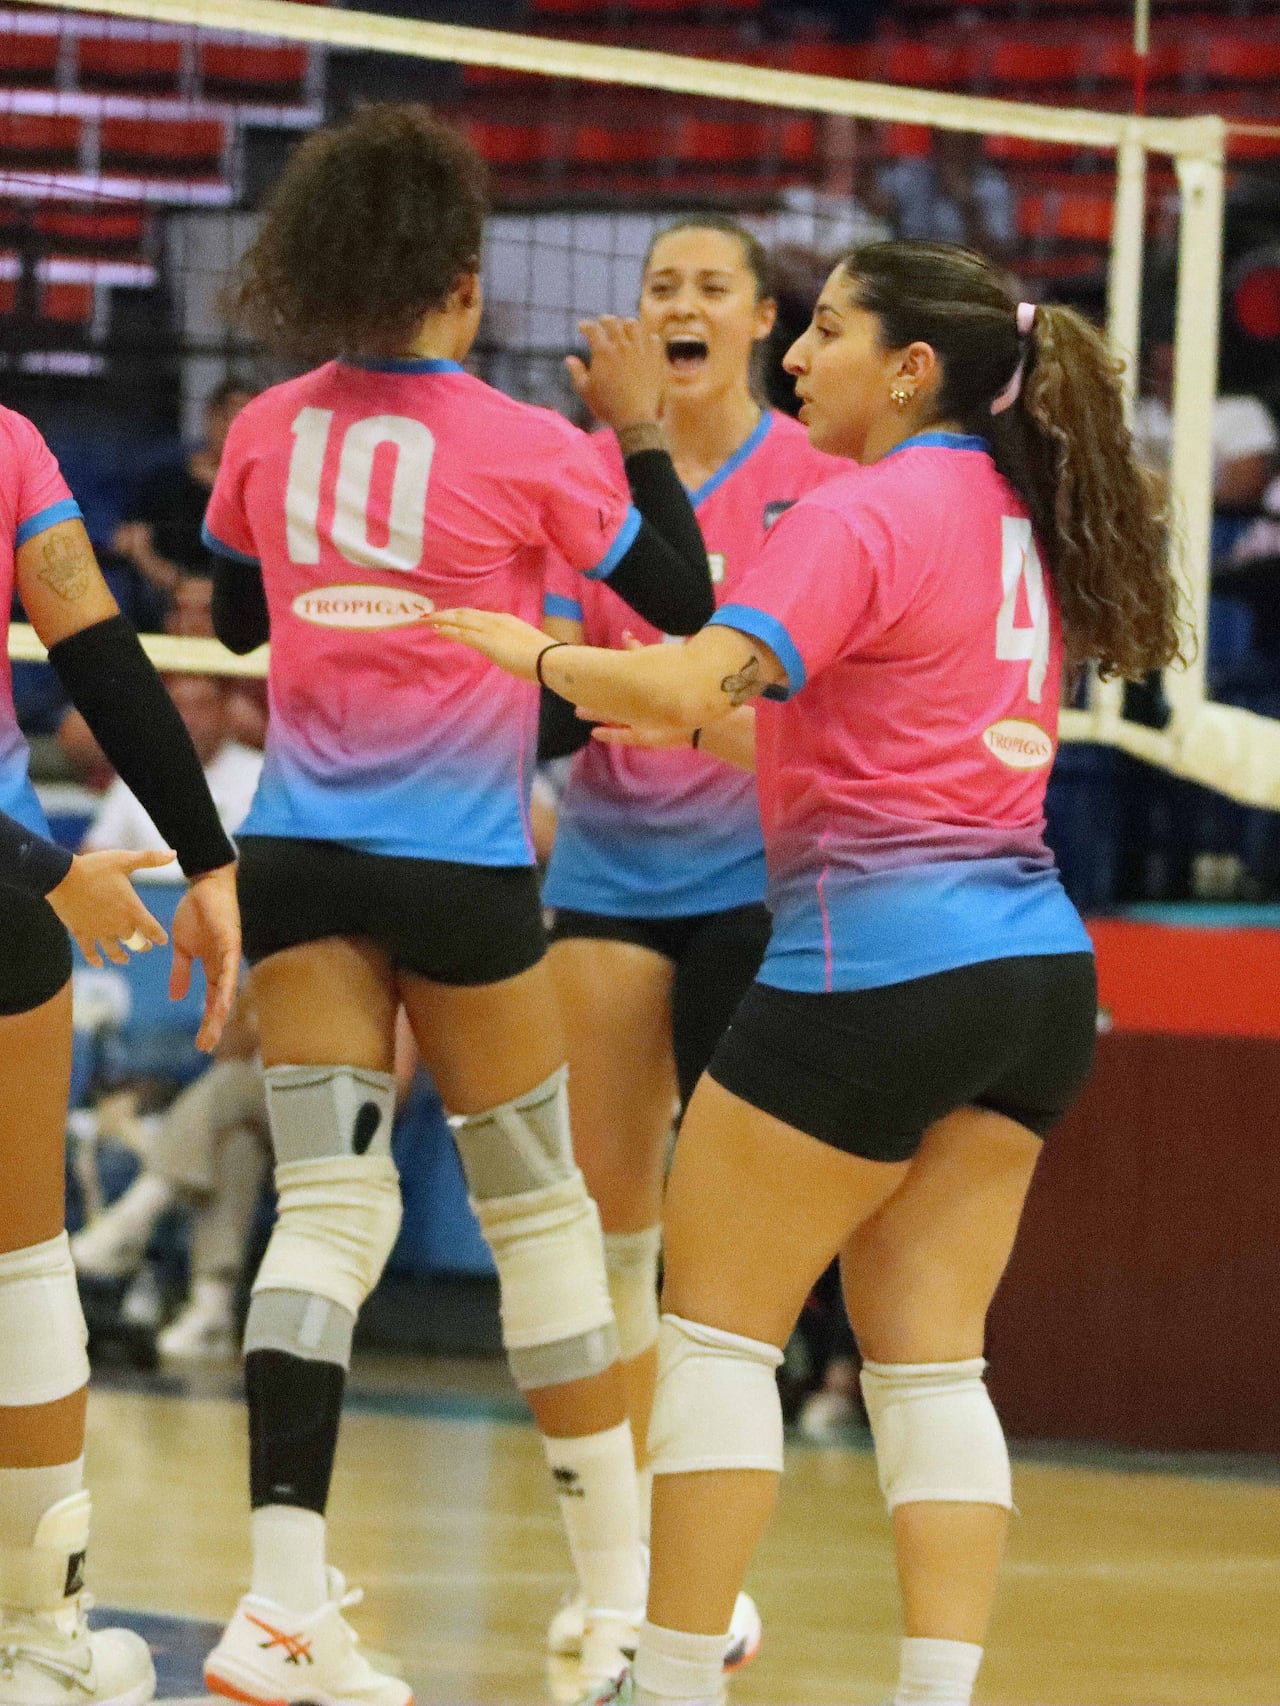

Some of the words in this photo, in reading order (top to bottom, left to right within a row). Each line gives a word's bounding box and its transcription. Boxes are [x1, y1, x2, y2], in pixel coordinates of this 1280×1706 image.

[285, 406, 436, 571] 10
[304, 600, 426, 615] TROPIGAS
[995, 514, 1050, 704] 4
[989, 731, 1049, 756] TROPIGAS
